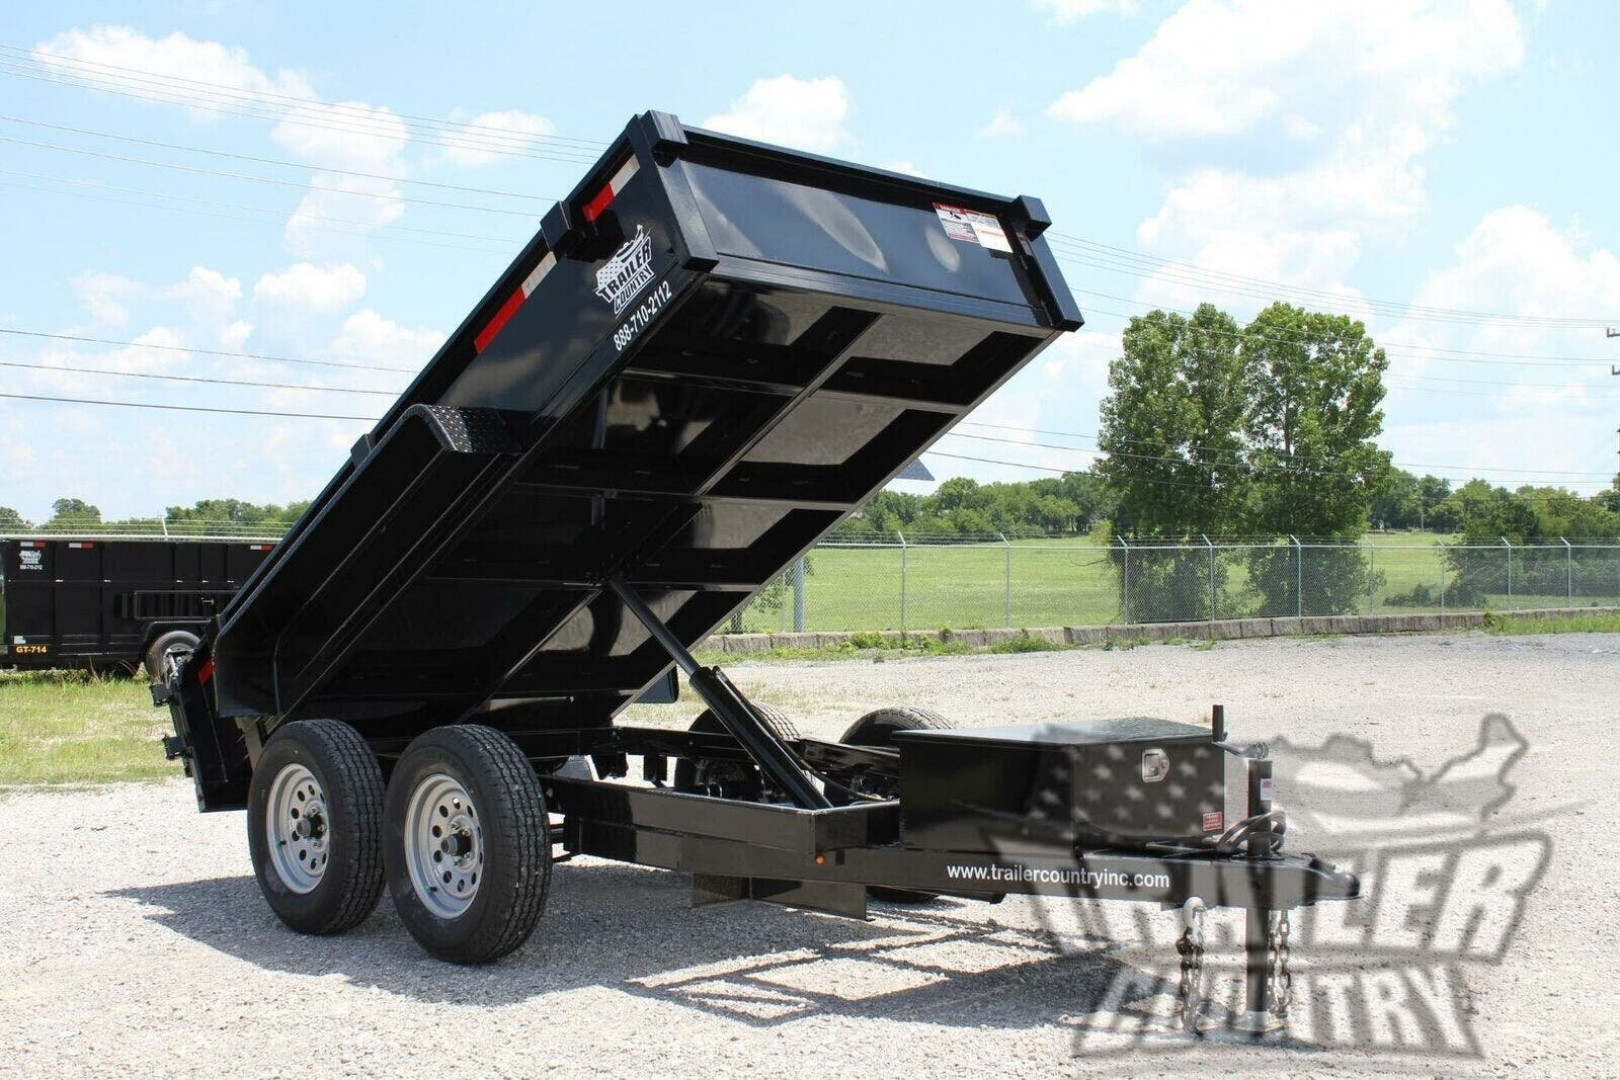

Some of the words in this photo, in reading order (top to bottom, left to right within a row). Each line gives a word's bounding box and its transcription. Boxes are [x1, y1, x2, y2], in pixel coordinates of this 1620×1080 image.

[600, 242, 652, 300] TRAILER
[614, 265, 655, 310] COUNTRY
[613, 280, 673, 351] 888-710-2112
[16, 645, 47, 654] GT-714
[947, 863, 1170, 888] www.trailercountryinc.com
